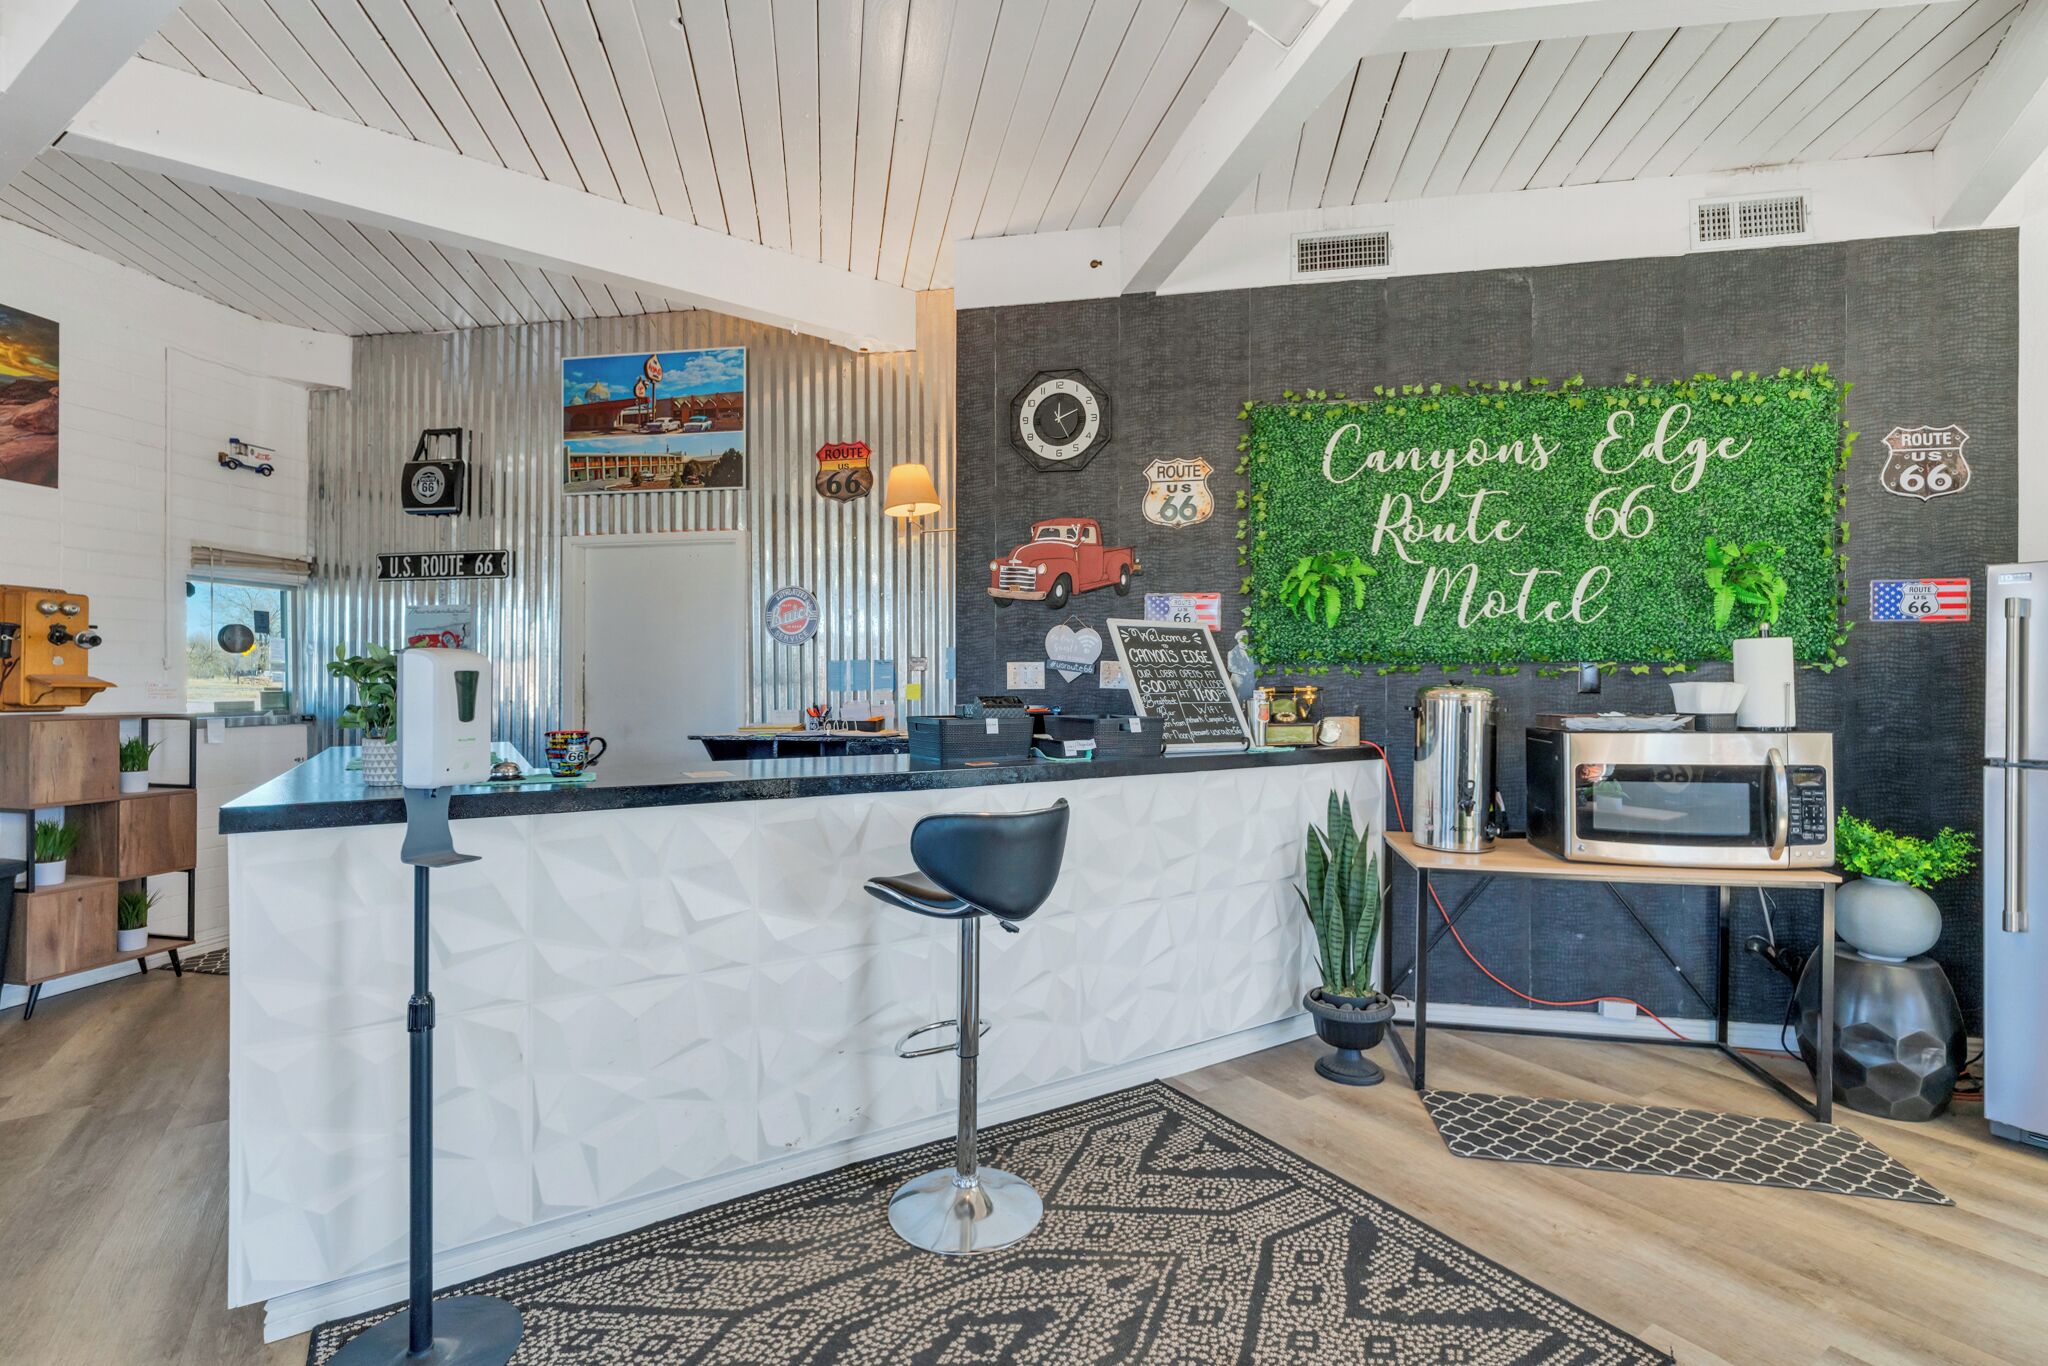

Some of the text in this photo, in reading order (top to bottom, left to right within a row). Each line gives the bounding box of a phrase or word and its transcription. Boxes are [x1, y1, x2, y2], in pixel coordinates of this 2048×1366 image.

[1040, 387, 1046, 395] 11
[1056, 381, 1064, 390] 12
[1027, 399, 1036, 408] 10
[1085, 396, 1093, 405] 2
[1022, 416, 1029, 425] 9
[1090, 413, 1098, 422] 3
[1027, 433, 1034, 441] 8
[1085, 431, 1092, 439] 4
[1901, 431, 1952, 447] ROUTE
[825, 447, 864, 460] ROUTE
[1038, 445, 1044, 453] 7
[1055, 449, 1063, 457] 6
[1073, 443, 1079, 452] 5
[1322, 403, 1753, 504] Canyons Edge
[1911, 450, 1942, 462] US
[837, 463, 850, 471] US
[1157, 464, 1201, 479] ROUTE
[826, 470, 861, 495] 66
[1900, 463, 1952, 492] 66
[421, 482, 434, 493] 66
[1166, 483, 1192, 494] US
[1159, 495, 1197, 522] 66
[1371, 484, 1656, 565] Route 66
[389, 553, 494, 578] U.S. ROUTE 66
[1413, 563, 1612, 630] Motel
[1908, 601, 1932, 614] 66
[1173, 612, 1192, 623] 66
[774, 629, 810, 642] SERVICE
[1127, 627, 1192, 643] Welcome
[1128, 647, 1213, 665] CANYON'S EDGE
[1050, 660, 1093, 673] #usroute66
[1136, 669, 1218, 679] OUR LOBBY OPENS AT
[1140, 679, 1167, 693] 6:00
[1166, 679, 1182, 690] AM
[1184, 679, 1201, 689] AND
[1179, 690, 1190, 698] AT
[1192, 688, 1220, 702] 11:00
[568, 751, 584, 762] 66
